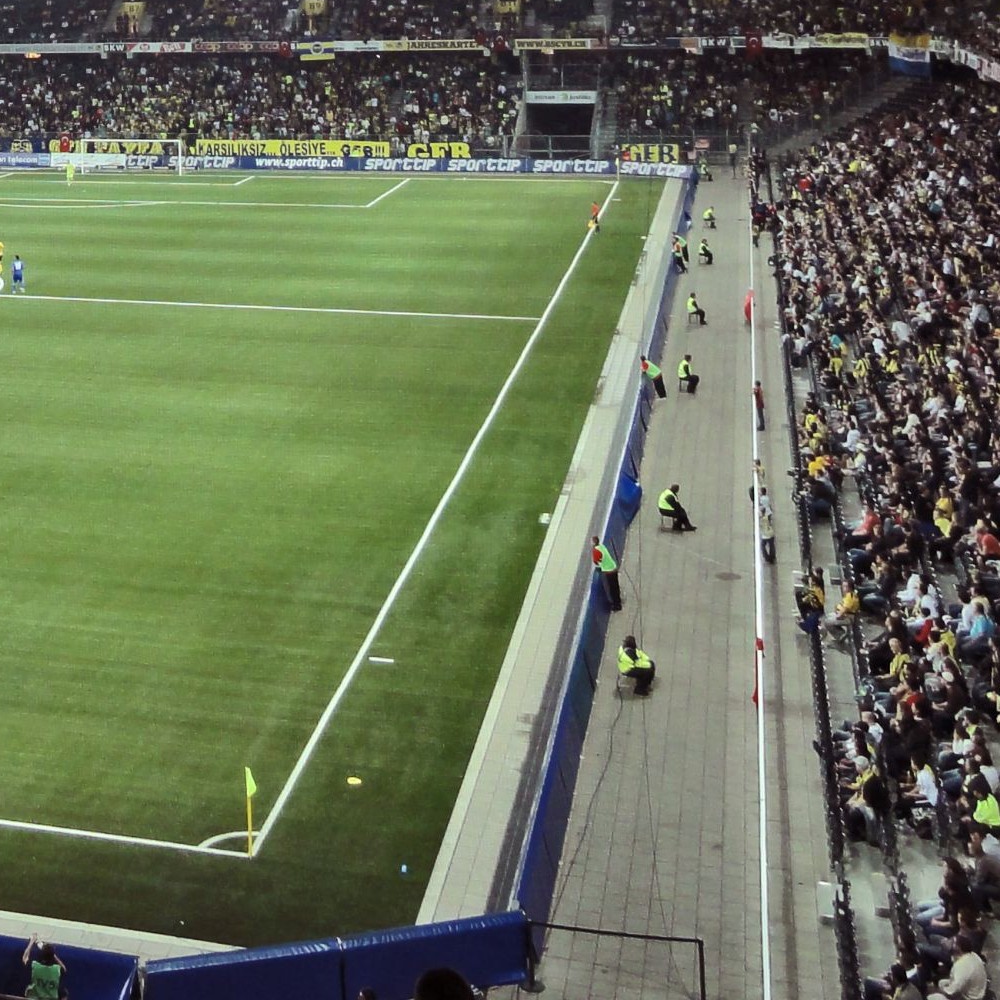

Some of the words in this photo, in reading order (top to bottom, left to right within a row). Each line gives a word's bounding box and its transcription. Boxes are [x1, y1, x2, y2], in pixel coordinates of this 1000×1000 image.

[702, 38, 726, 47] BKW
[104, 44, 125, 52] BKW
[255, 157, 344, 169] www.sporttip.ch
